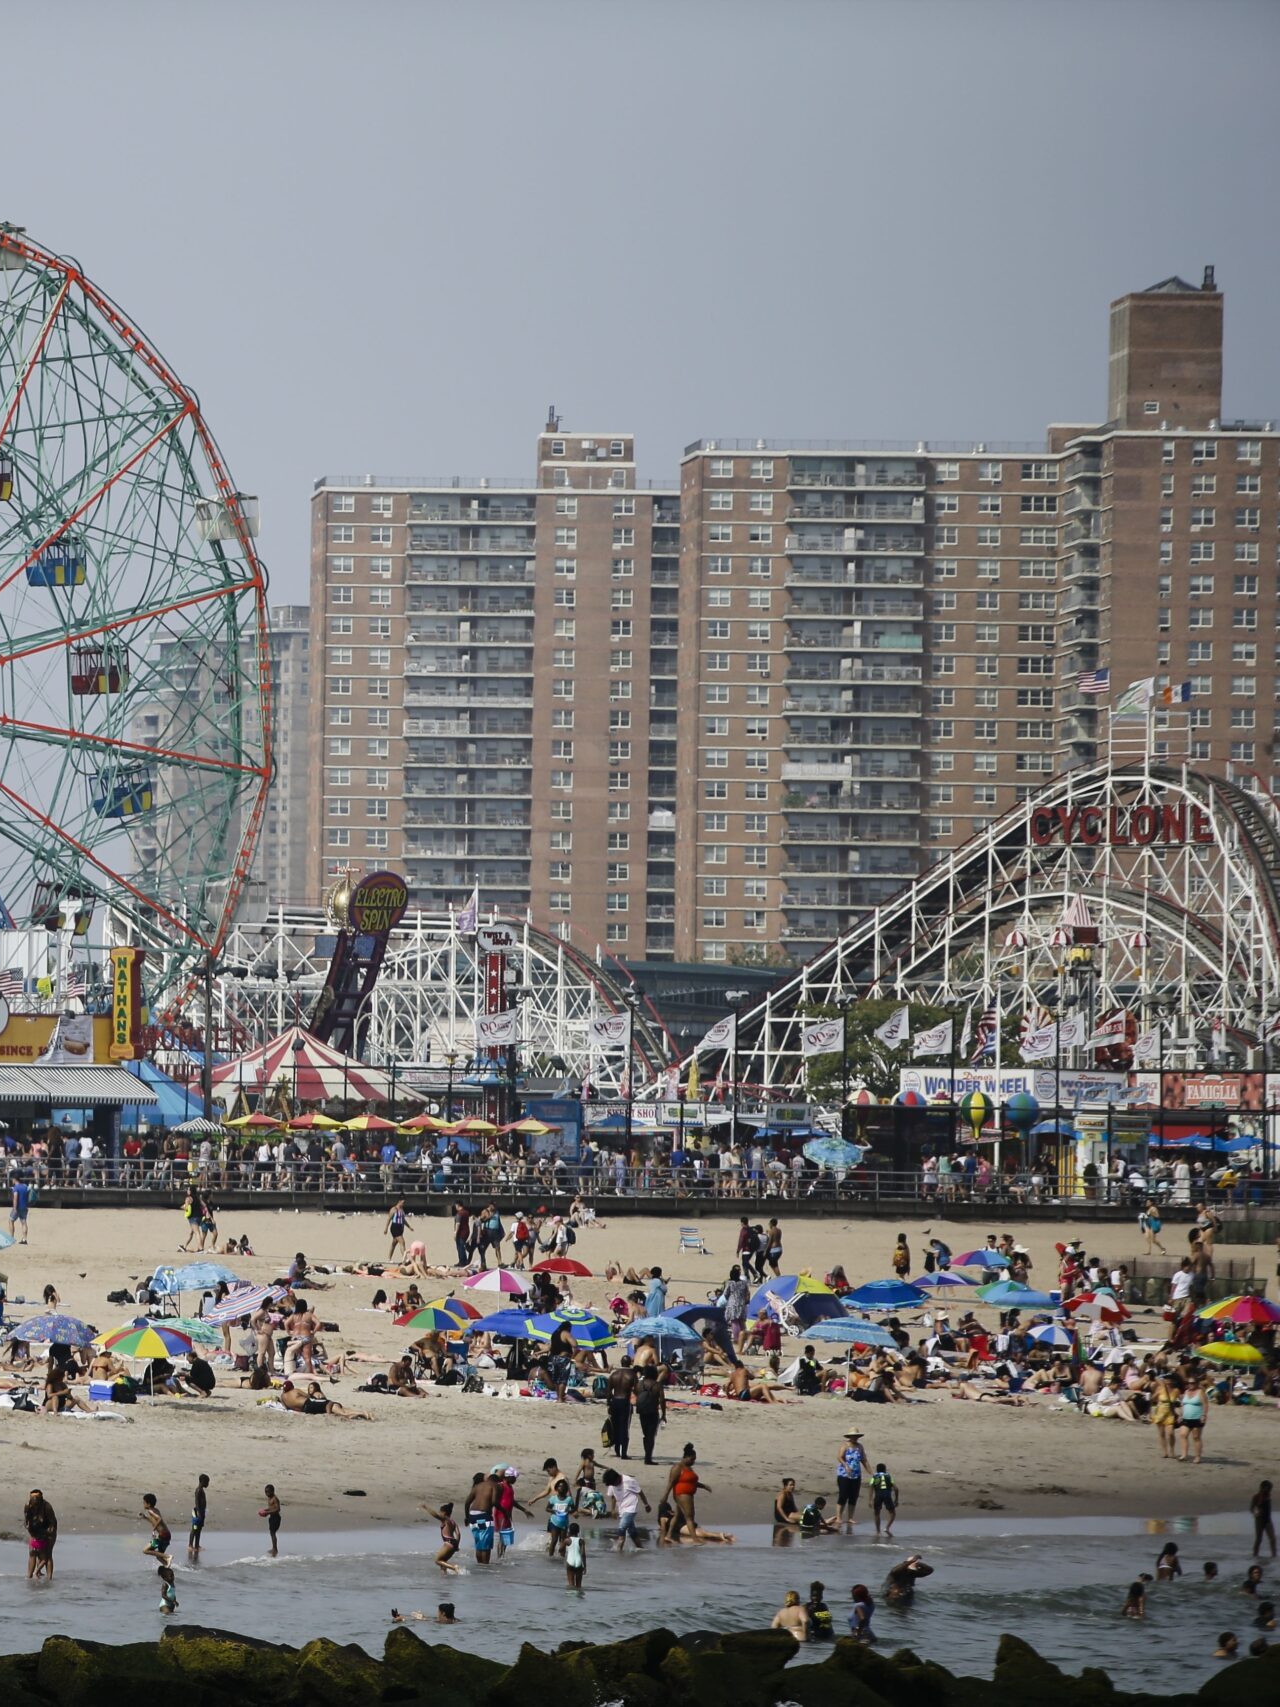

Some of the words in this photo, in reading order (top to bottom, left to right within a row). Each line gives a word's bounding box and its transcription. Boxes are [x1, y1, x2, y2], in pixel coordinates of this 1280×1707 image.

[1031, 802, 1214, 845] CYCLONE
[354, 887, 406, 907] ELECTRO
[360, 909, 392, 931] SPIN
[482, 931, 503, 939] TWIST
[117, 956, 128, 1044] NATHANS
[0, 1045, 33, 1056] SINCE
[924, 1076, 980, 1095] WONDER
[985, 1077, 1031, 1094] WHEEL
[1187, 1085, 1237, 1100] FAMIGLIA
[607, 1107, 635, 1117] SWET
[637, 1108, 656, 1118] SHO
